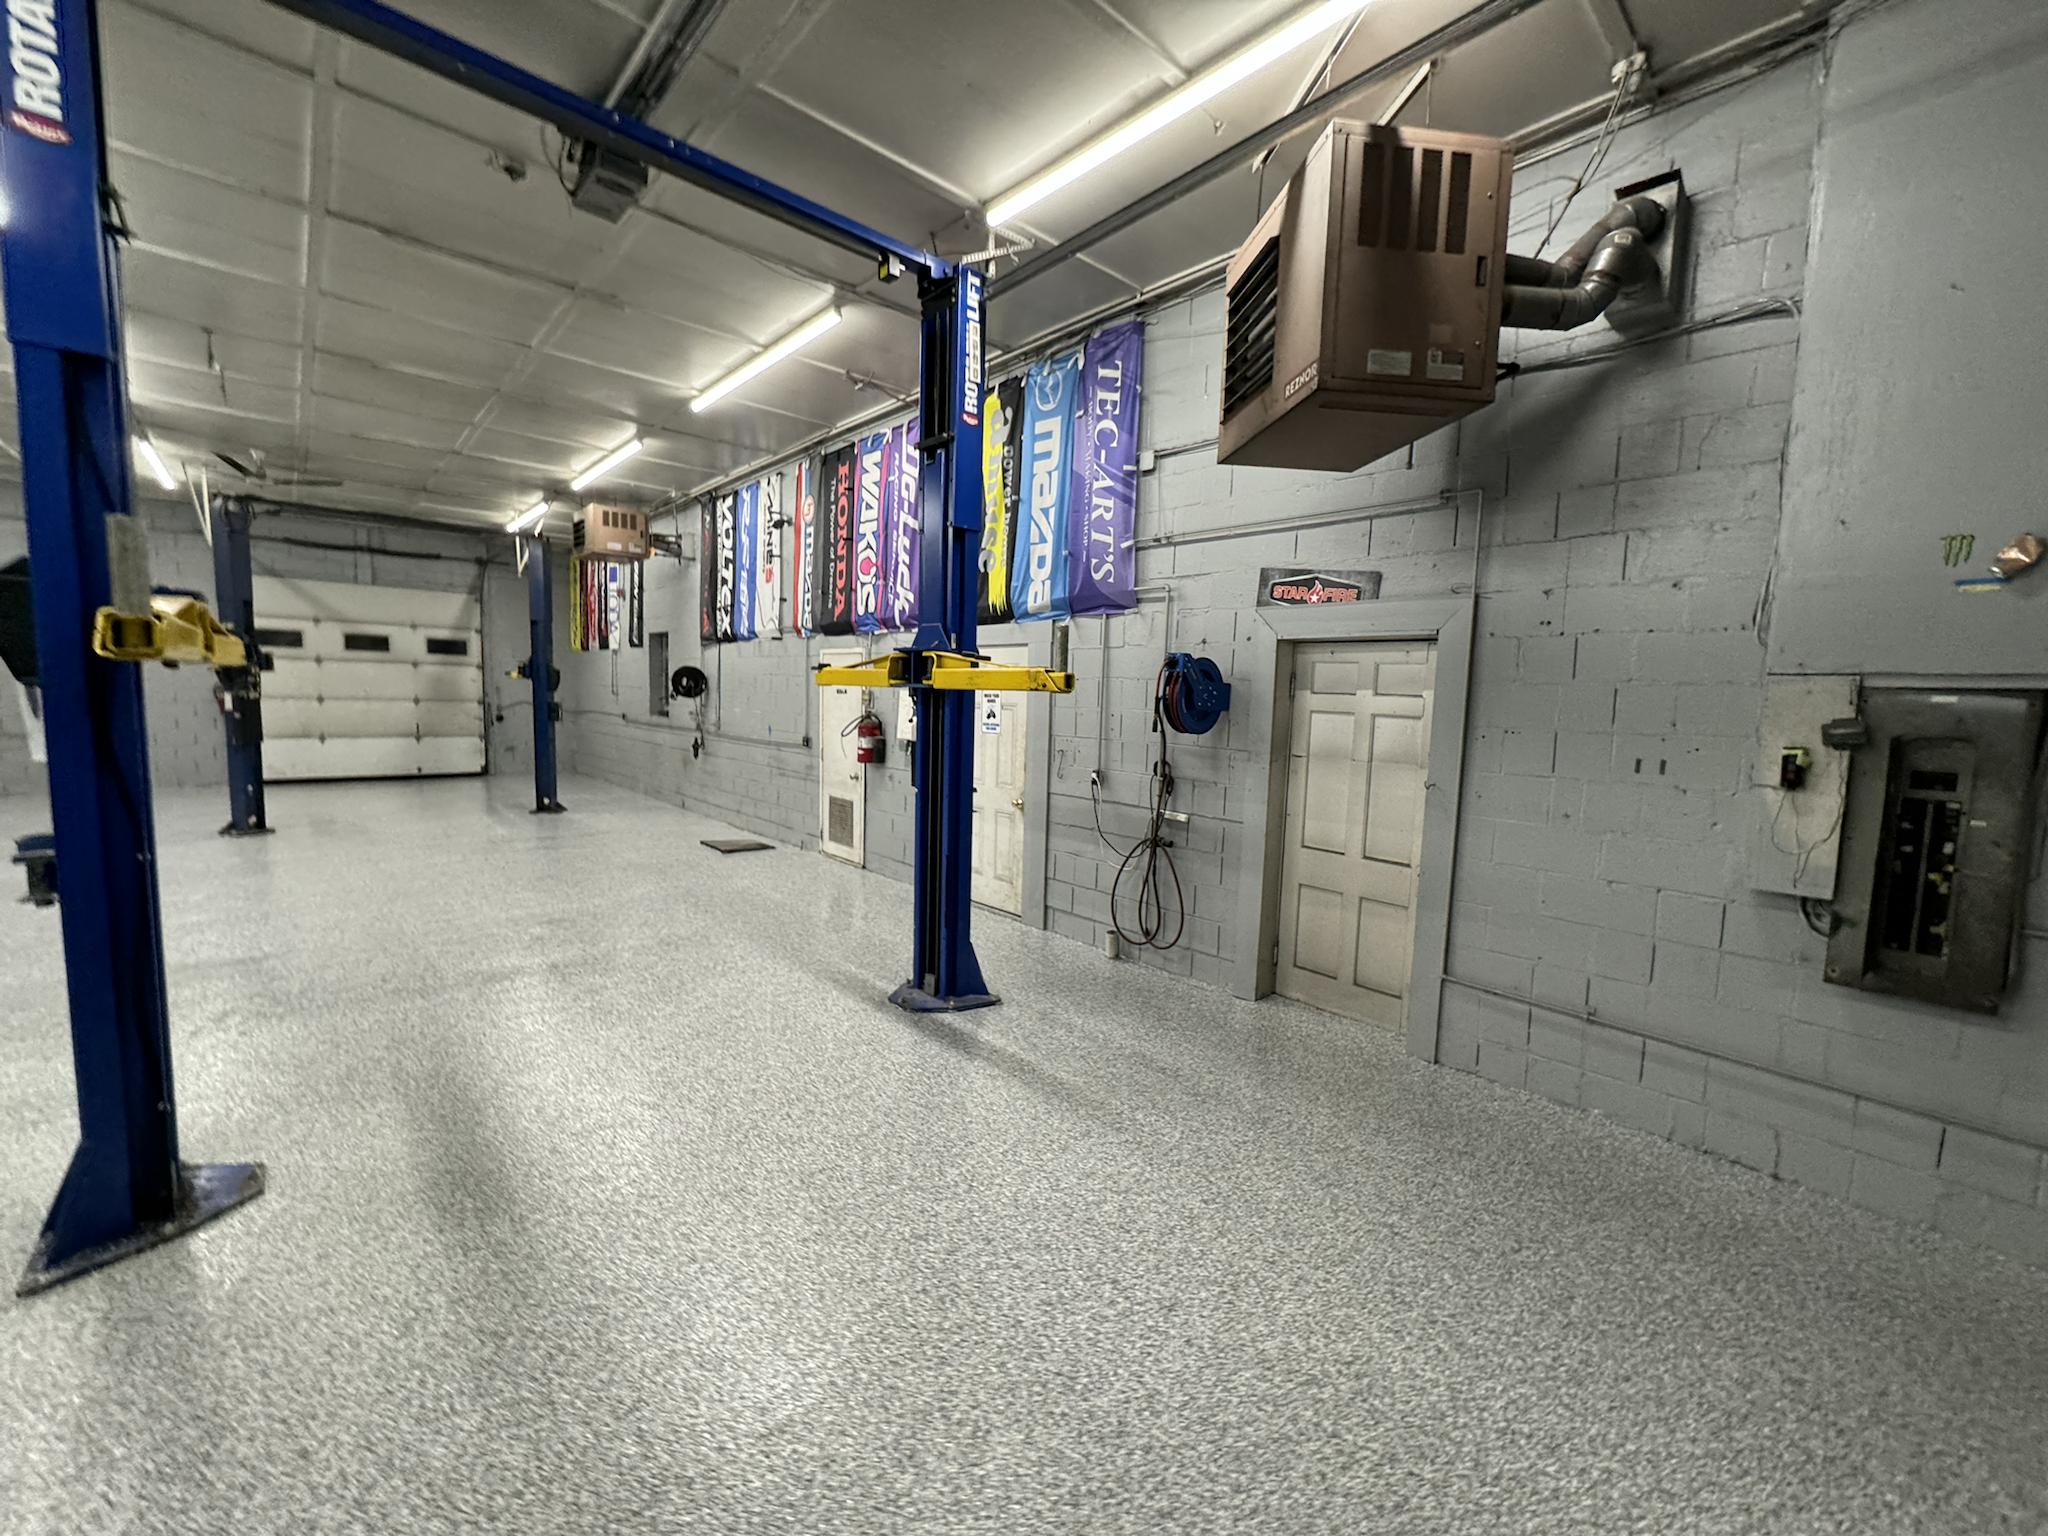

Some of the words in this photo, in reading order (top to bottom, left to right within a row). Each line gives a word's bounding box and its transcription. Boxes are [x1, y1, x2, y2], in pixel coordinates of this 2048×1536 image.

[1284, 362, 1318, 399] REZNOR
[833, 460, 850, 622] HONDA
[856, 449, 881, 617] WAKO'S
[1090, 359, 1123, 584] TEC-ART'S
[721, 493, 734, 639] VOLTEX
[1272, 584, 1308, 601] STAR
[1322, 587, 1358, 603] FIRE
